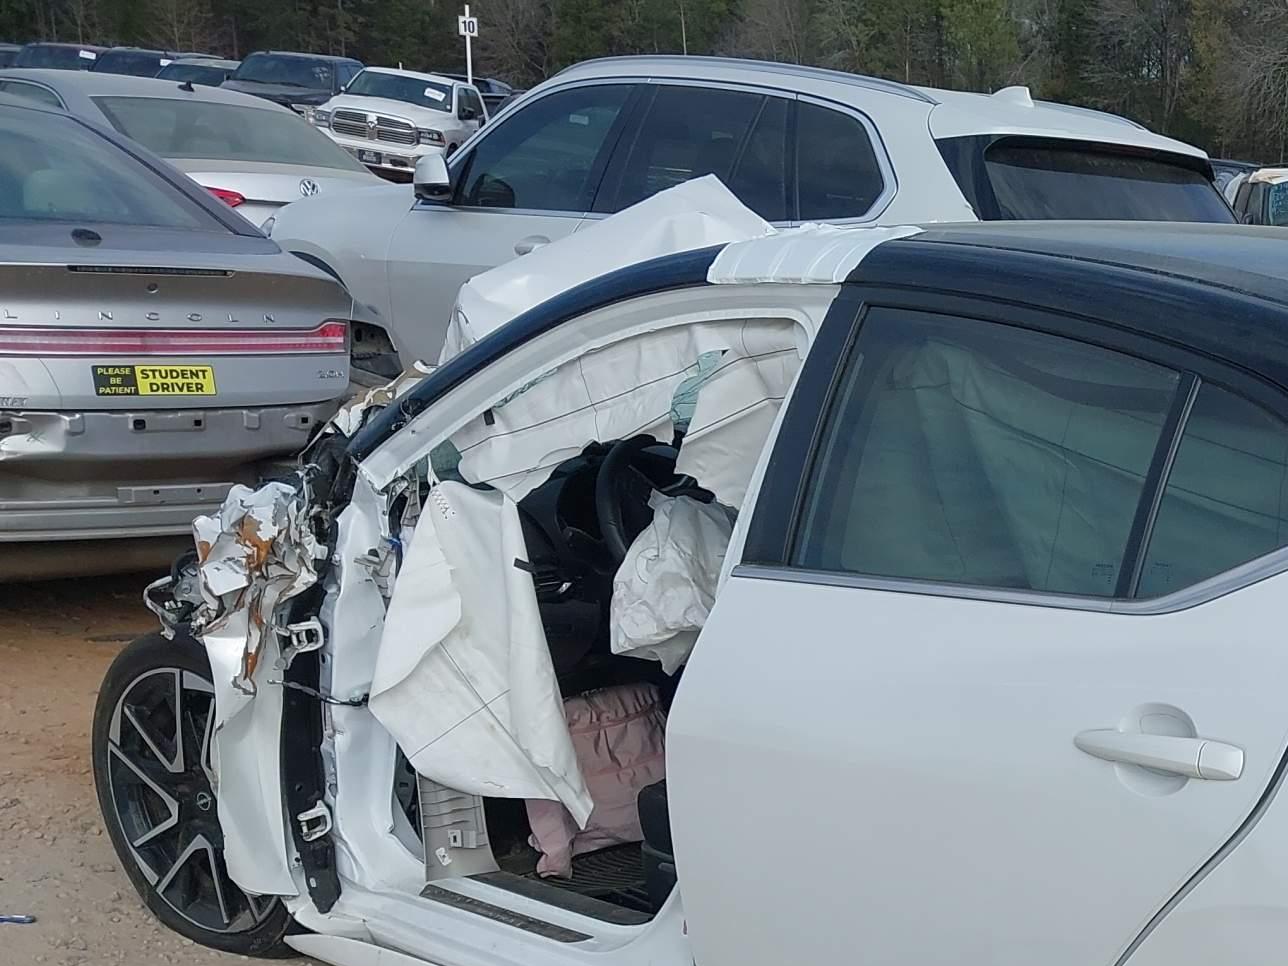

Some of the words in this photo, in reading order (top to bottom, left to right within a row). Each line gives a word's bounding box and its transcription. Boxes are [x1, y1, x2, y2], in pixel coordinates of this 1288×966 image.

[461, 19, 475, 34] 10
[4, 309, 275, 324] LINCOLN
[97, 367, 131, 375] PLEASE
[140, 368, 208, 380] STUDENT
[109, 377, 122, 385] BE
[99, 386, 136, 394] PATIENT
[149, 382, 204, 393] DRIVER
